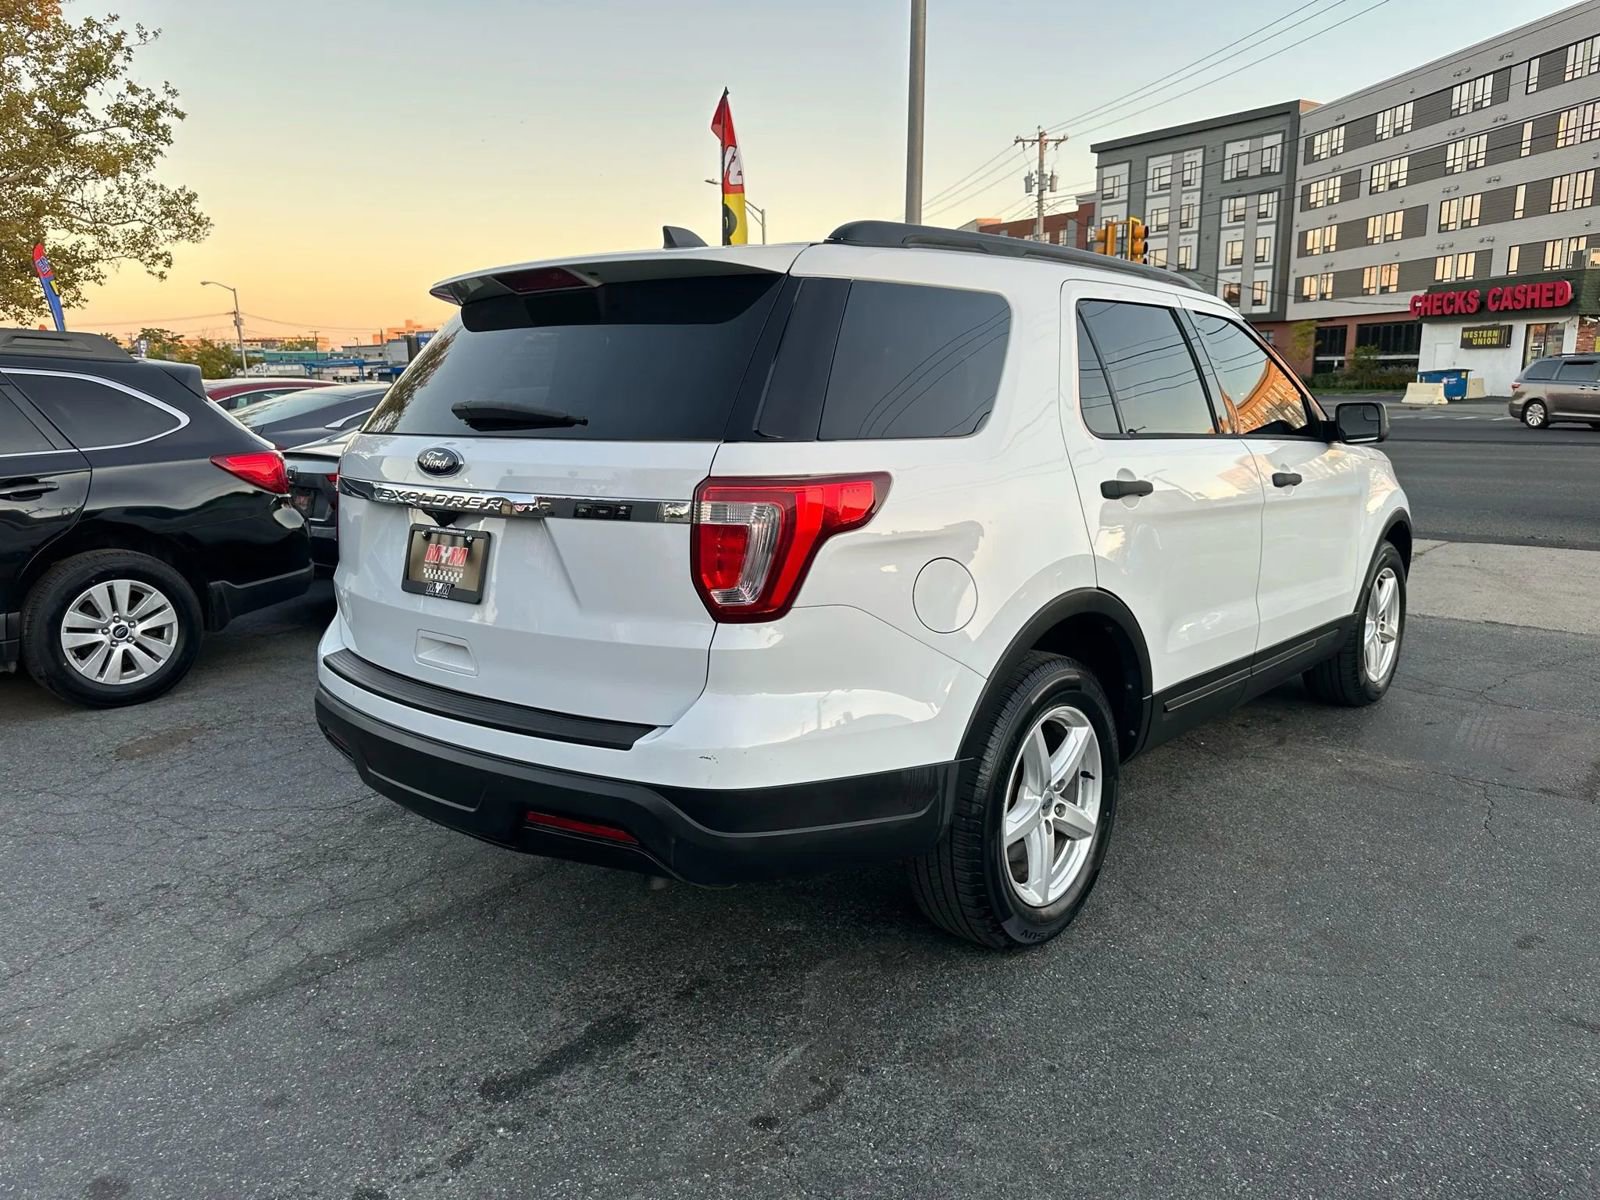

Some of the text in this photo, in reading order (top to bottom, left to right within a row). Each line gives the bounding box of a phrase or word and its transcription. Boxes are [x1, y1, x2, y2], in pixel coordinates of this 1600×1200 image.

[1409, 280, 1571, 317] CHECKS CASHED
[1463, 330, 1499, 339] WESTERN
[1472, 337, 1498, 346] UNION
[423, 450, 449, 470] Ford
[378, 487, 503, 511] EXPLORER
[425, 543, 469, 567] MYM
